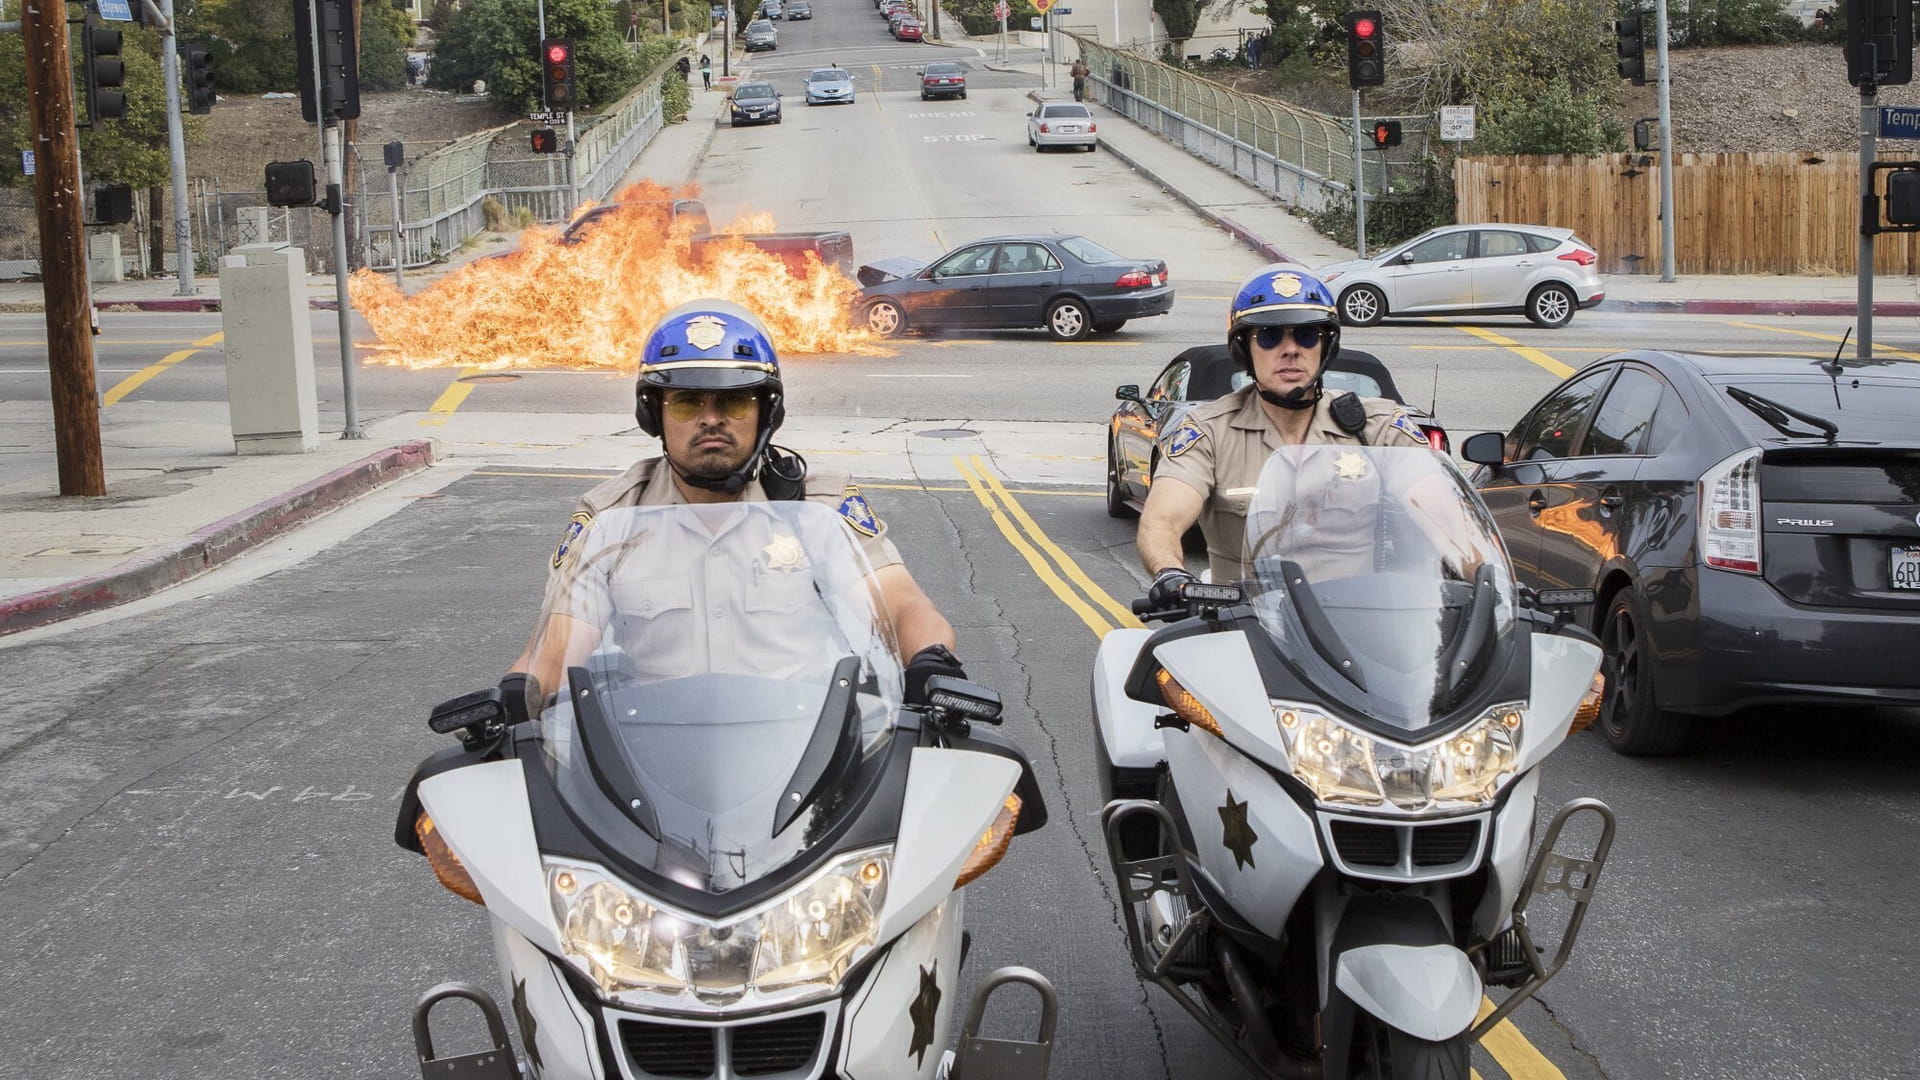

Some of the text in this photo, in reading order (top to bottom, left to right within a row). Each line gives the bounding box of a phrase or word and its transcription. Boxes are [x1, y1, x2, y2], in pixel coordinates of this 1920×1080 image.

[530, 112, 553, 120] TEMPLE
[908, 111, 976, 119] AHEAD
[923, 134, 986, 142] STOP
[1776, 518, 1834, 527] PRIUS
